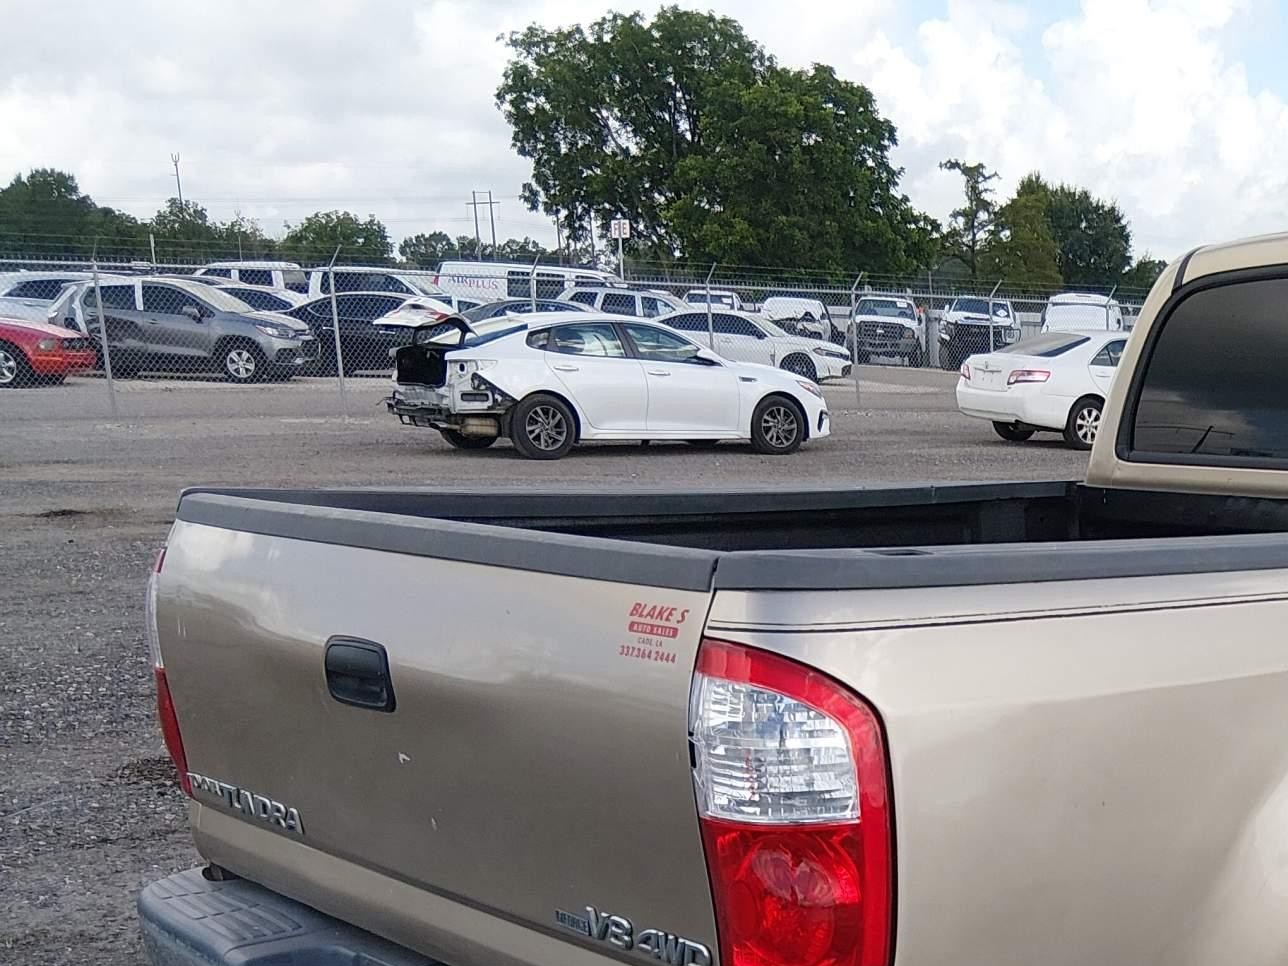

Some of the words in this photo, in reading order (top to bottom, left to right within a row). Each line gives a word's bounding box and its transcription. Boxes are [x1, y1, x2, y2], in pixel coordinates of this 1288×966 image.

[633, 623, 651, 633] AUTO
[653, 626, 674, 637] SALES
[585, 905, 634, 951] V8
